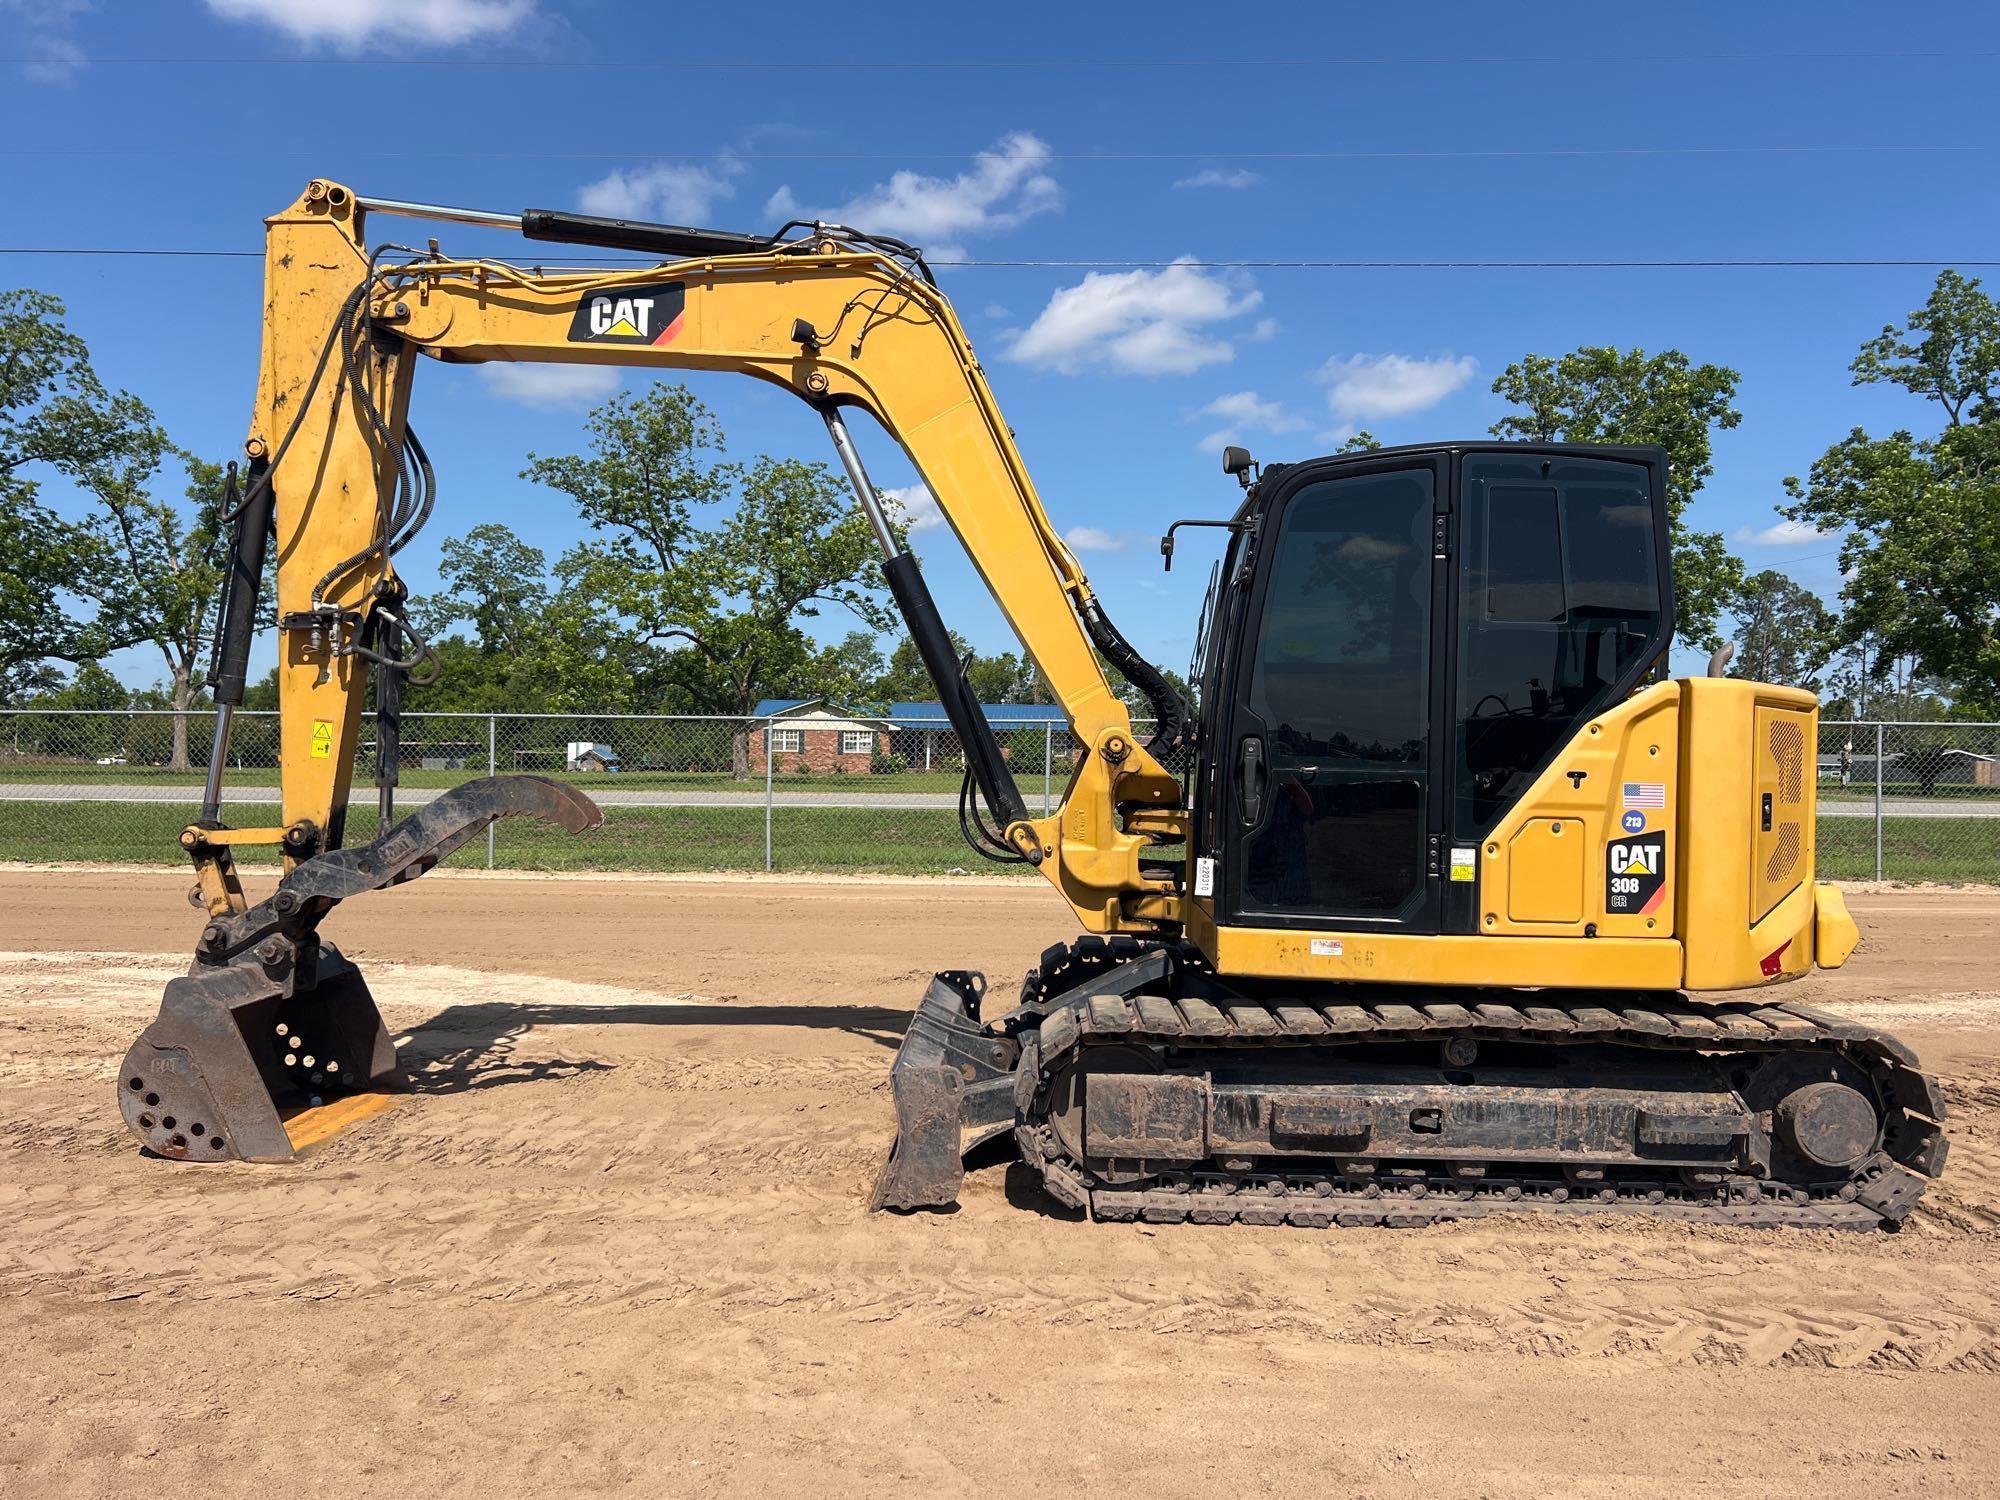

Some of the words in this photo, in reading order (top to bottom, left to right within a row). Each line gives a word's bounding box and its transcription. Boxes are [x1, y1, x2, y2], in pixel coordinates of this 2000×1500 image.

[590, 297, 654, 337] CAT
[1625, 816, 1642, 828] 213
[1611, 844, 1661, 875] CAT
[1201, 866, 1210, 891] 220310
[1611, 878, 1639, 894] 308
[1611, 895, 1627, 907] CR
